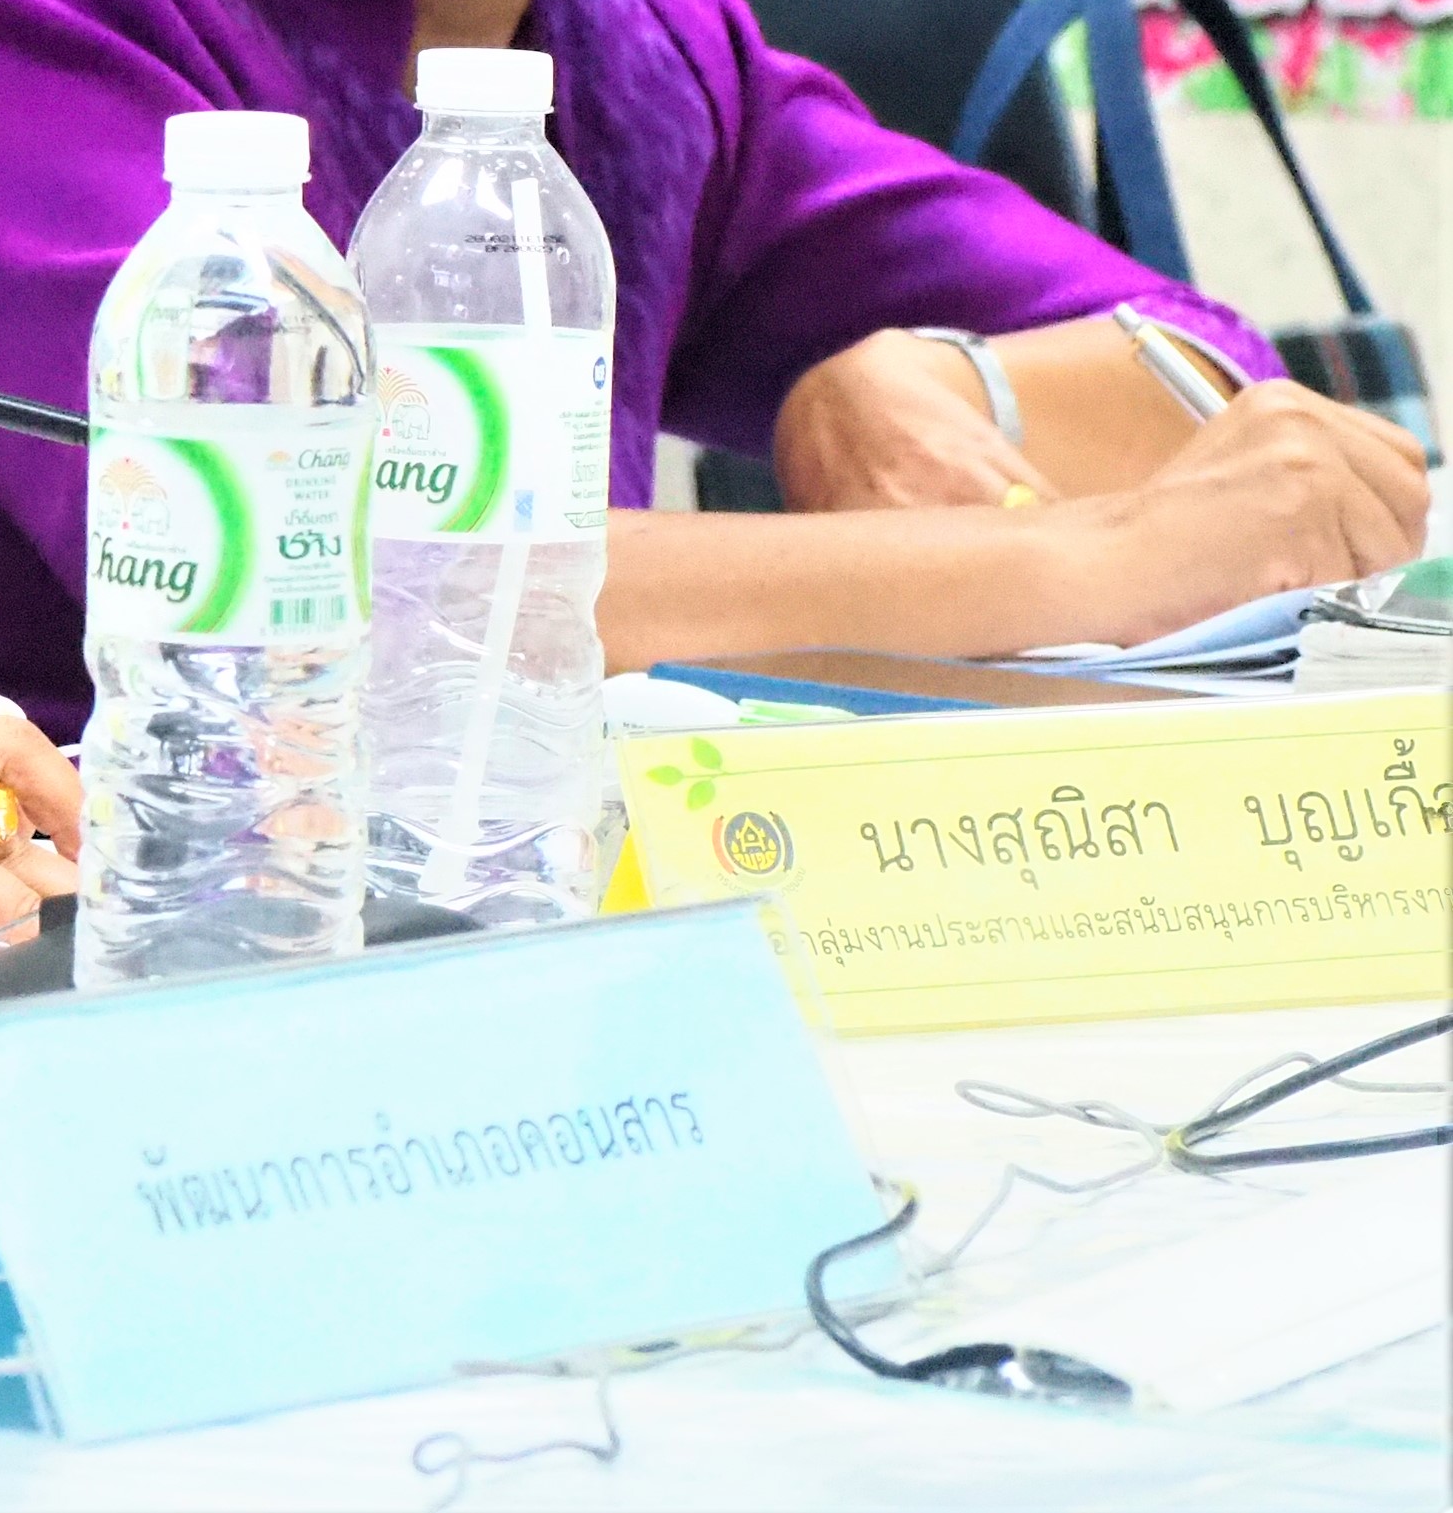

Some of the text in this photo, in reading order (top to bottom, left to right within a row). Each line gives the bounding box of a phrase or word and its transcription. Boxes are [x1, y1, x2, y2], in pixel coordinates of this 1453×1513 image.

[860, 784, 1180, 891] นางสุณิสา
[136, 1091, 704, 1235] พัฒนาการอำเภอคอนสาร
